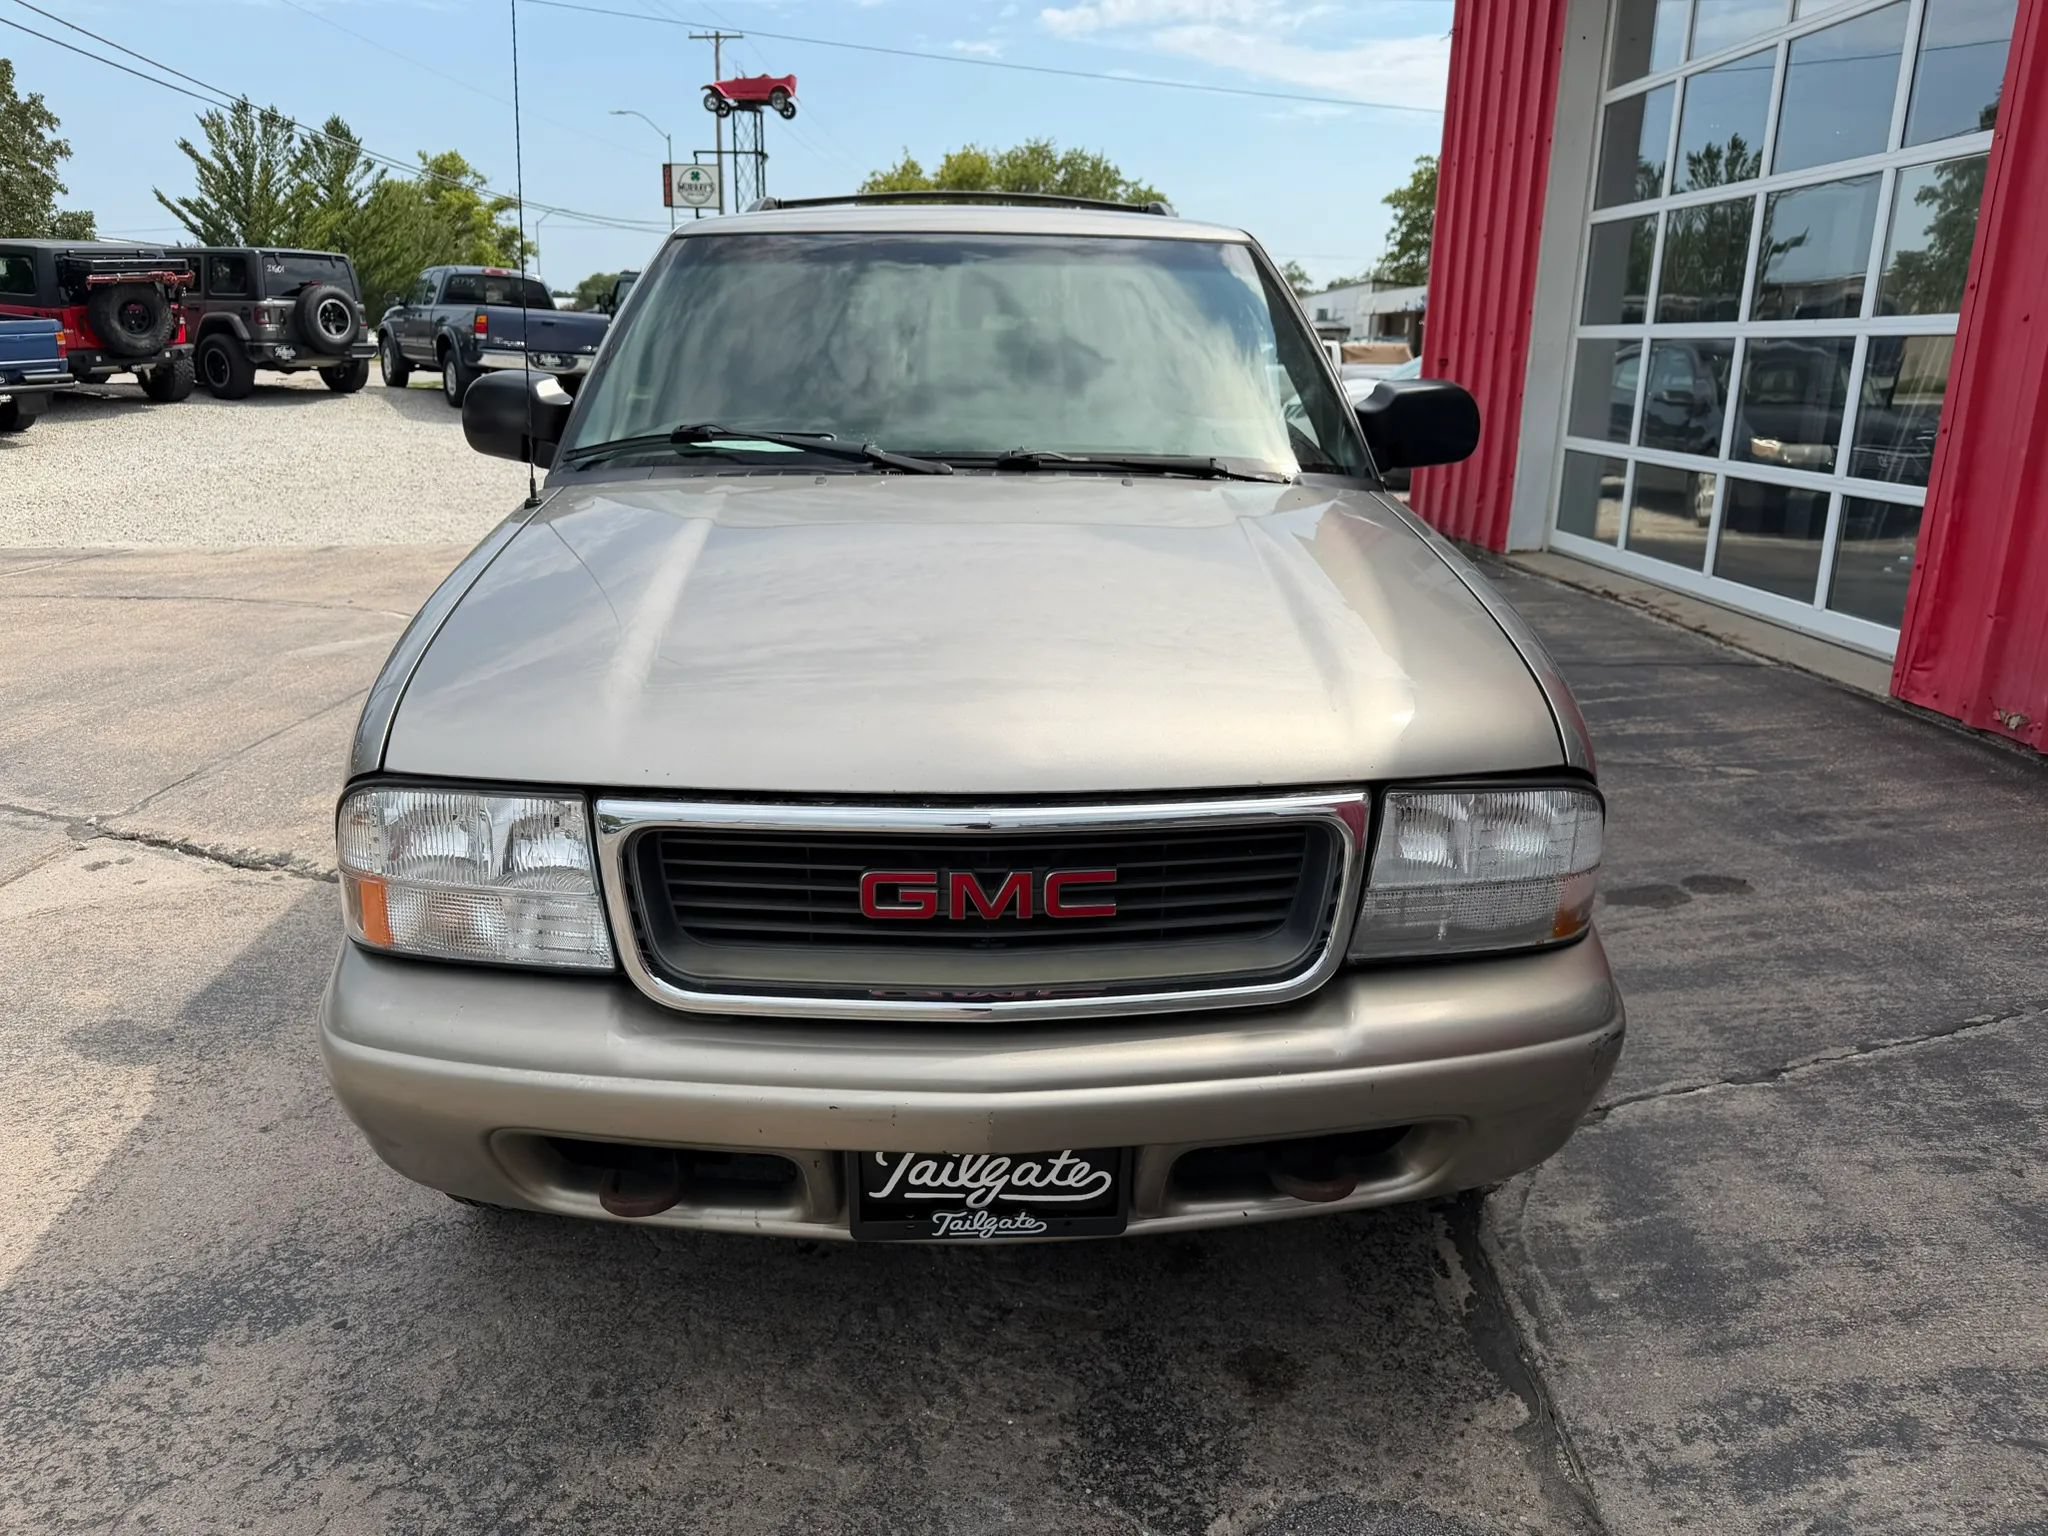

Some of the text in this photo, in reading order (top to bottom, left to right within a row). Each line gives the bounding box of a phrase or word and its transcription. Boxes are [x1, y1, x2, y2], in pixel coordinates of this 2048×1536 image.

[859, 868, 1118, 921] GMC
[868, 1149, 1112, 1208] Tailgate
[931, 1210, 1048, 1238] Tailgate
